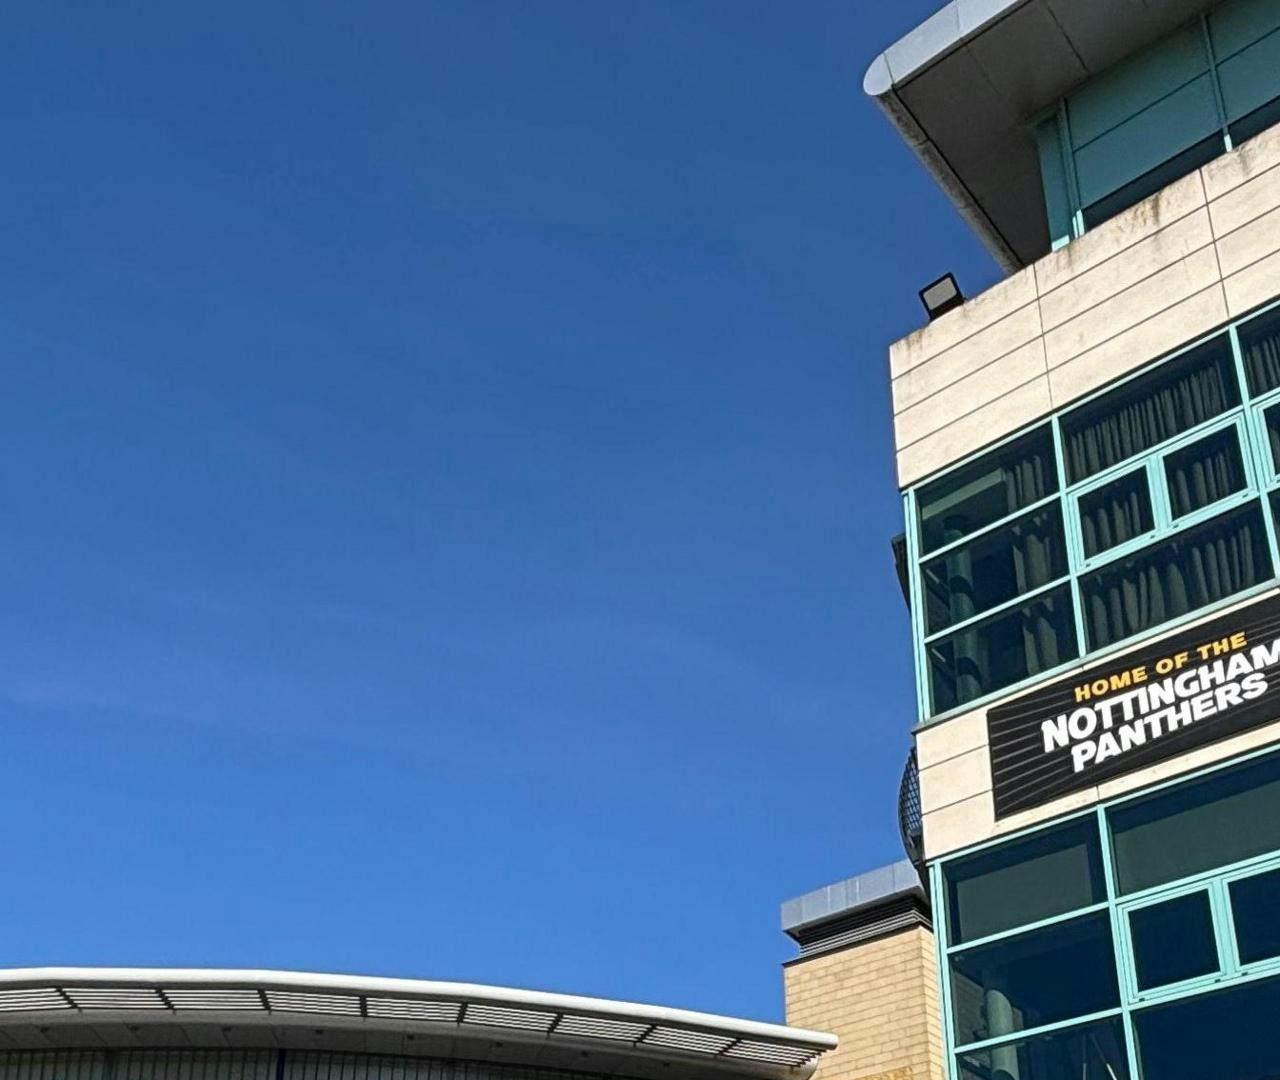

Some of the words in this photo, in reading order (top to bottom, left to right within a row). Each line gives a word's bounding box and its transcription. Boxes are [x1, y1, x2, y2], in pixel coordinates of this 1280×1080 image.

[1074, 666, 1148, 702] HOME
[1156, 651, 1189, 674] OF
[1197, 631, 1247, 660] THE
[1071, 672, 1269, 773] PANTHERS
